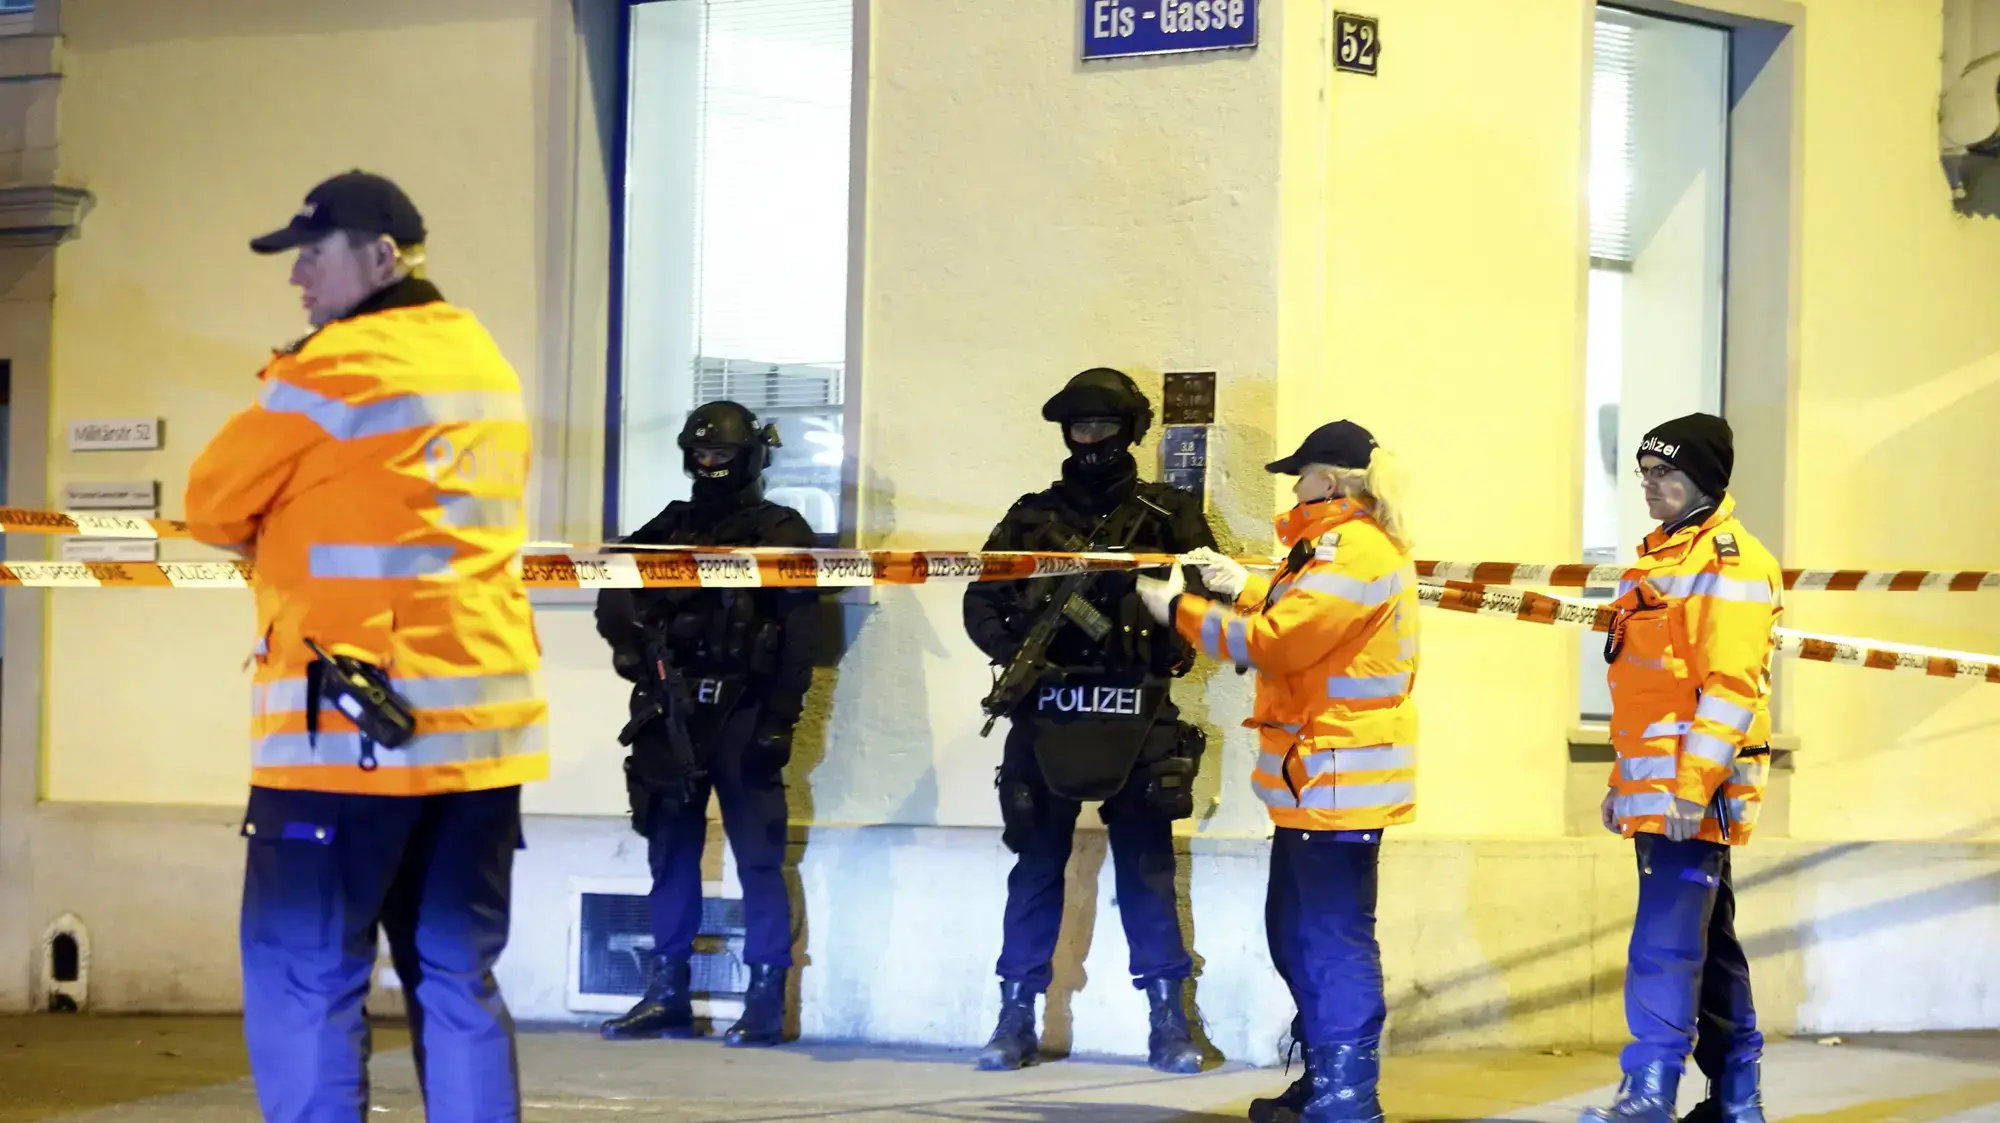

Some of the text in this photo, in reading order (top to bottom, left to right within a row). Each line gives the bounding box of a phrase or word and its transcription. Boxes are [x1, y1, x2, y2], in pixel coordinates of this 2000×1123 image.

[1093, 0, 1135, 38] Eis
[1160, 0, 1245, 33] Gasse
[1341, 22, 1375, 66] 52
[136, 423, 151, 441] 52
[1639, 437, 1681, 459] olizei
[638, 559, 754, 580] POLIZEI-SPERRZONE
[1037, 686, 1142, 714] POLIZEI
